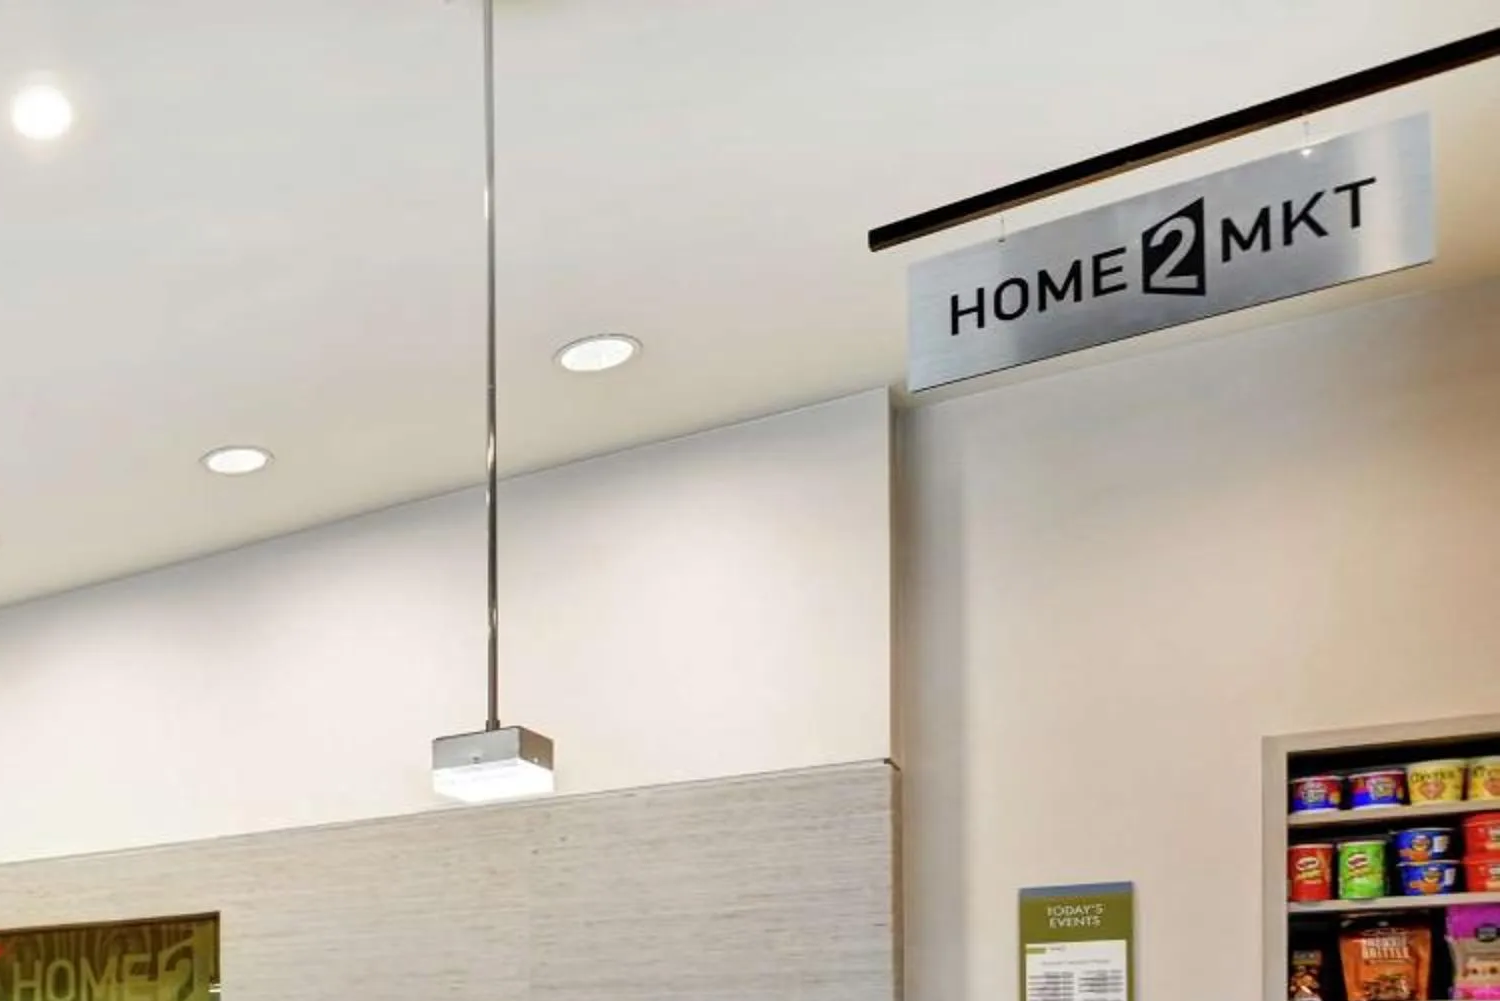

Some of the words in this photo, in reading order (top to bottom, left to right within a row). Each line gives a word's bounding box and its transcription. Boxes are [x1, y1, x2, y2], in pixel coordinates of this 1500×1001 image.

[950, 246, 1128, 336] HOME
[1220, 177, 1376, 263] MKT
[1047, 903, 1104, 917] TODAY'S
[1049, 916, 1101, 929] EVENTS
